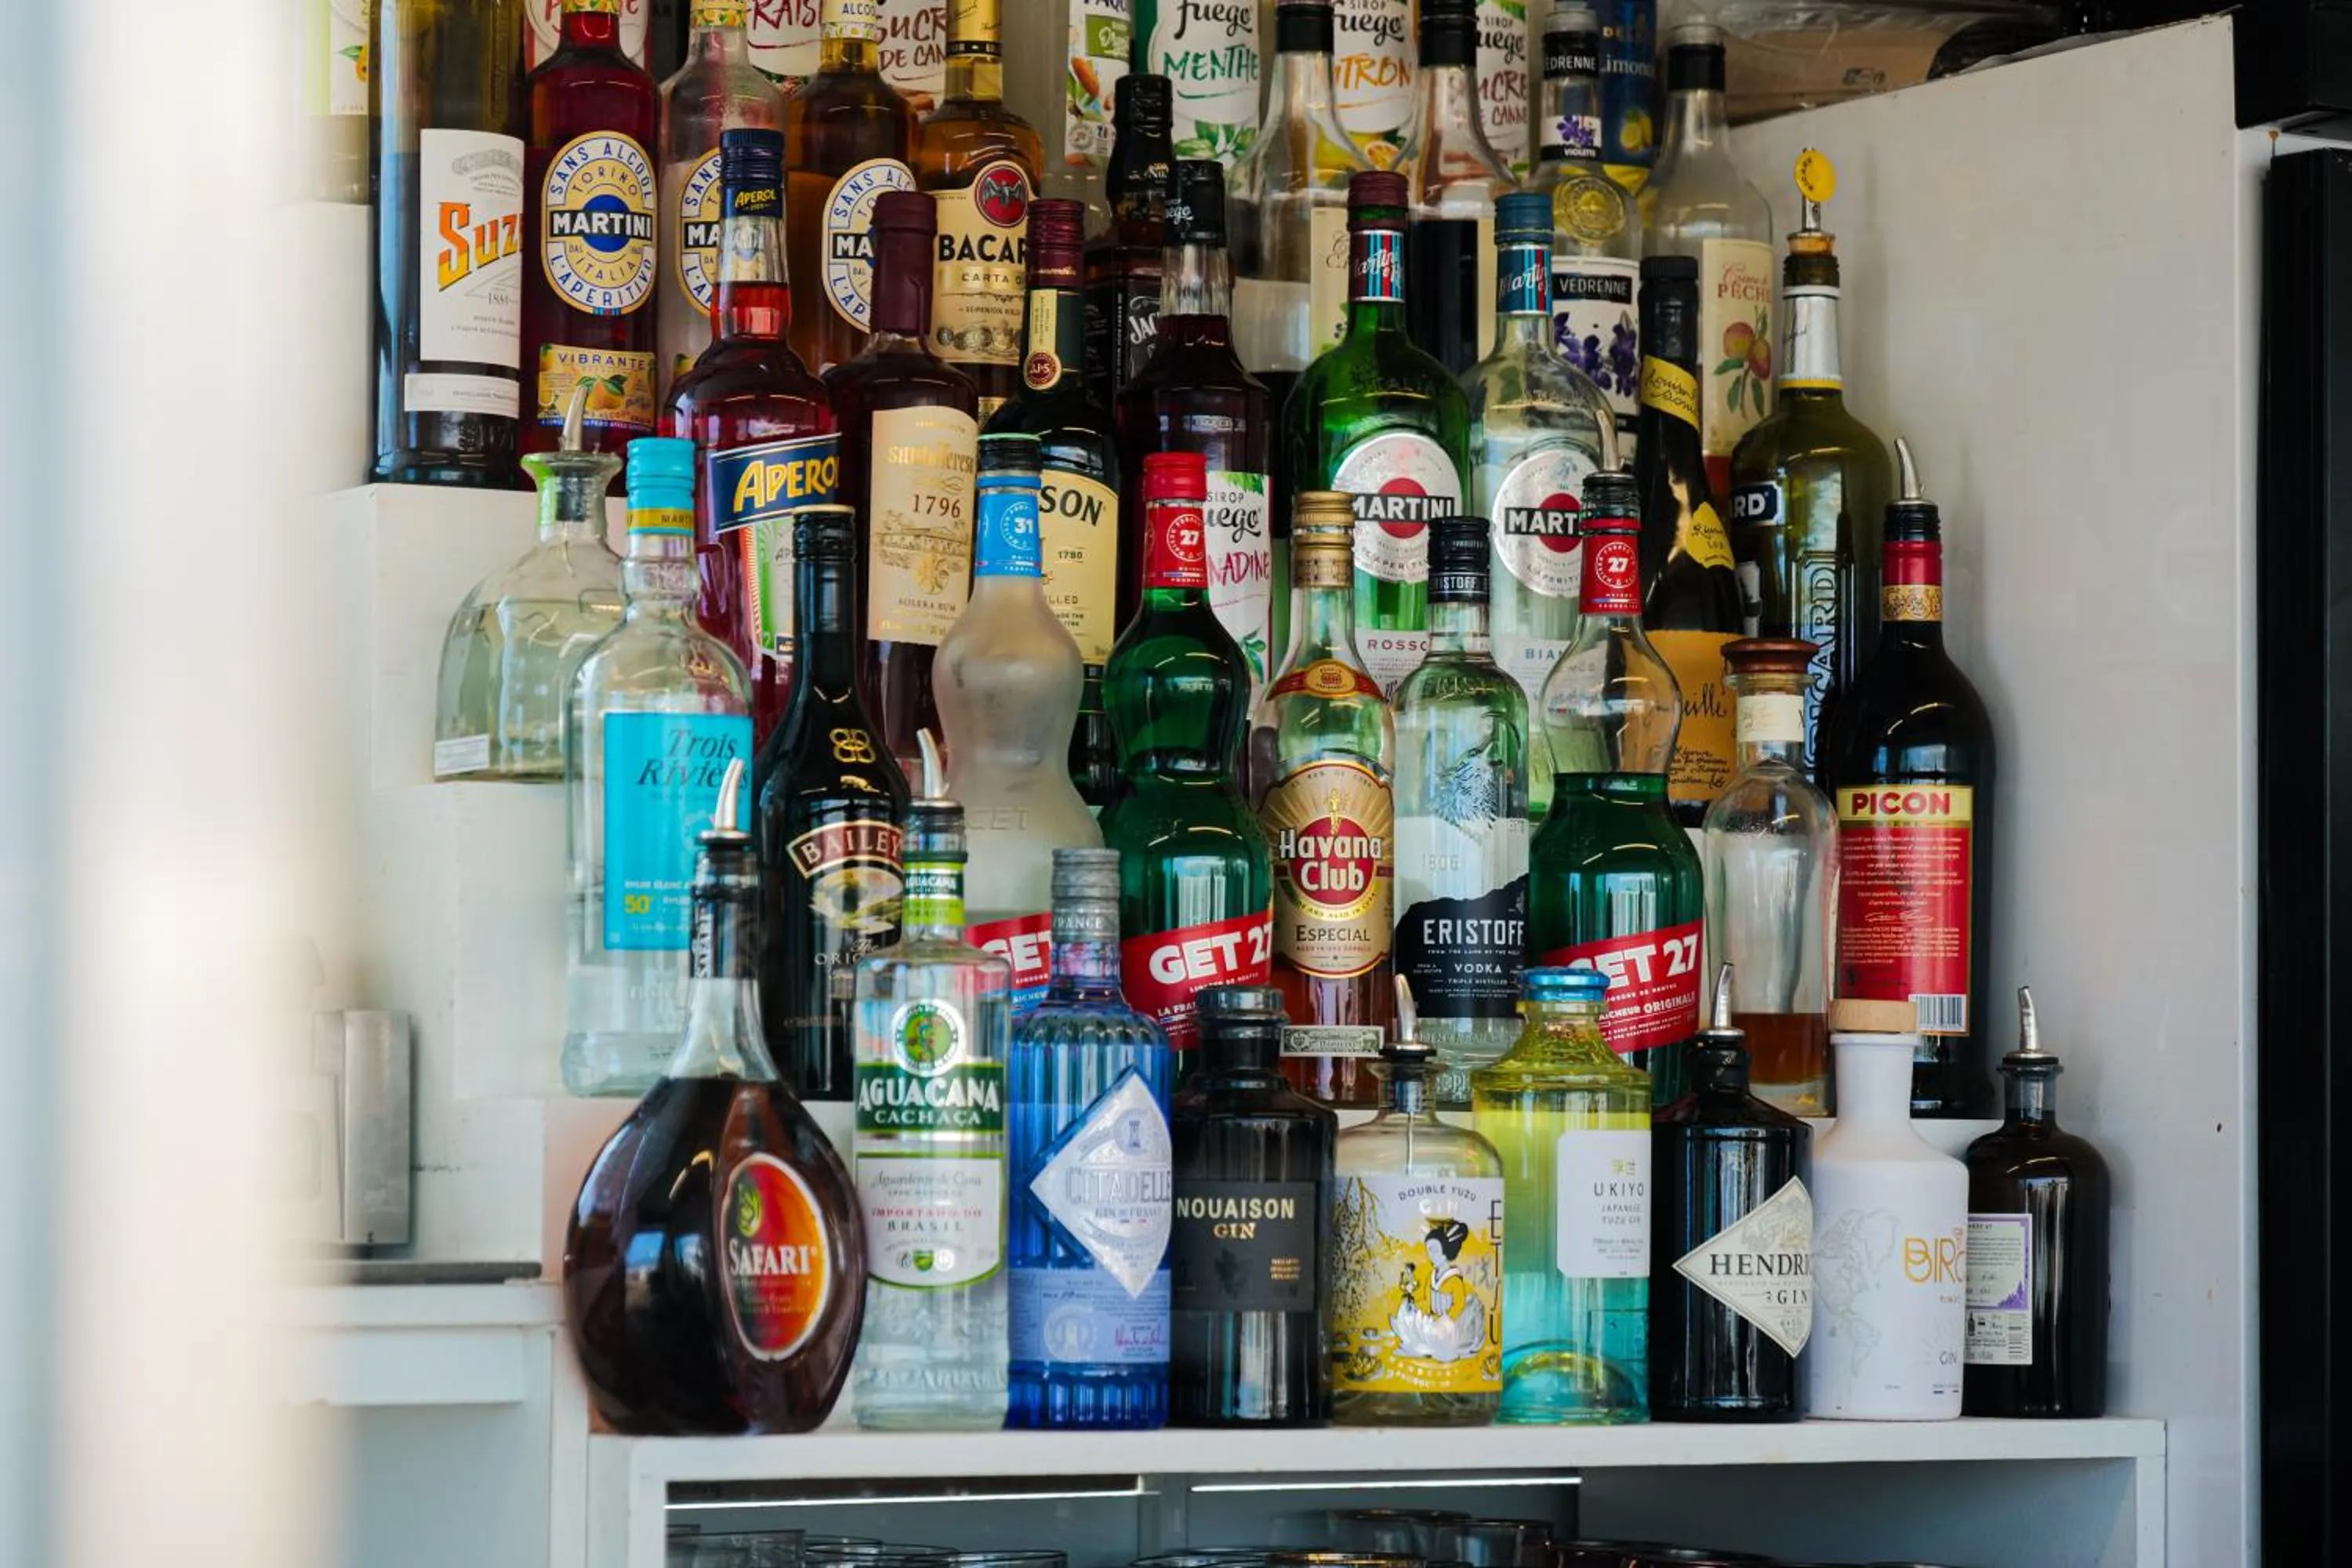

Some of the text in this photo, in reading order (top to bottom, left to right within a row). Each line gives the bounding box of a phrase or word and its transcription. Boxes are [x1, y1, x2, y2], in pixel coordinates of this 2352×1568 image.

[550, 144, 590, 197] SANS
[601, 140, 652, 200] ALCOOL
[572, 165, 640, 197] TORINO
[833, 172, 875, 218] SANS
[551, 212, 654, 235] MARTINI
[1559, 278, 1628, 296] VEDRENNE
[557, 352, 647, 370] VIBRANTE
[913, 494, 961, 518] 1796
[1014, 517, 1033, 534] 31
[1507, 510, 1584, 535] MART
[1179, 529, 1200, 546] 27
[1607, 558, 1629, 573] 27
[668, 728, 738, 759] Trois
[637, 757, 750, 789] Riviès
[1850, 792, 1952, 816] PICON
[1279, 828, 1382, 860] Havana
[1300, 861, 1365, 892] Club
[1295, 924, 1371, 942] ESPECIAL
[1423, 920, 1525, 946] ERISTOFF
[1149, 931, 1243, 985] GET
[1662, 933, 1700, 978] 27
[1454, 963, 1503, 975] VODKA
[857, 1076, 1000, 1113] AGUACANA
[874, 1109, 982, 1127] CACHAÇA
[1399, 1183, 1477, 1202] DOUBLE YUZU
[1594, 1182, 1645, 1196] UKIYO
[1176, 1197, 1295, 1219] NOUAISON
[887, 1221, 964, 1232] BRASIL
[1213, 1221, 1257, 1240] GIN
[728, 1237, 812, 1276] SAFARI
